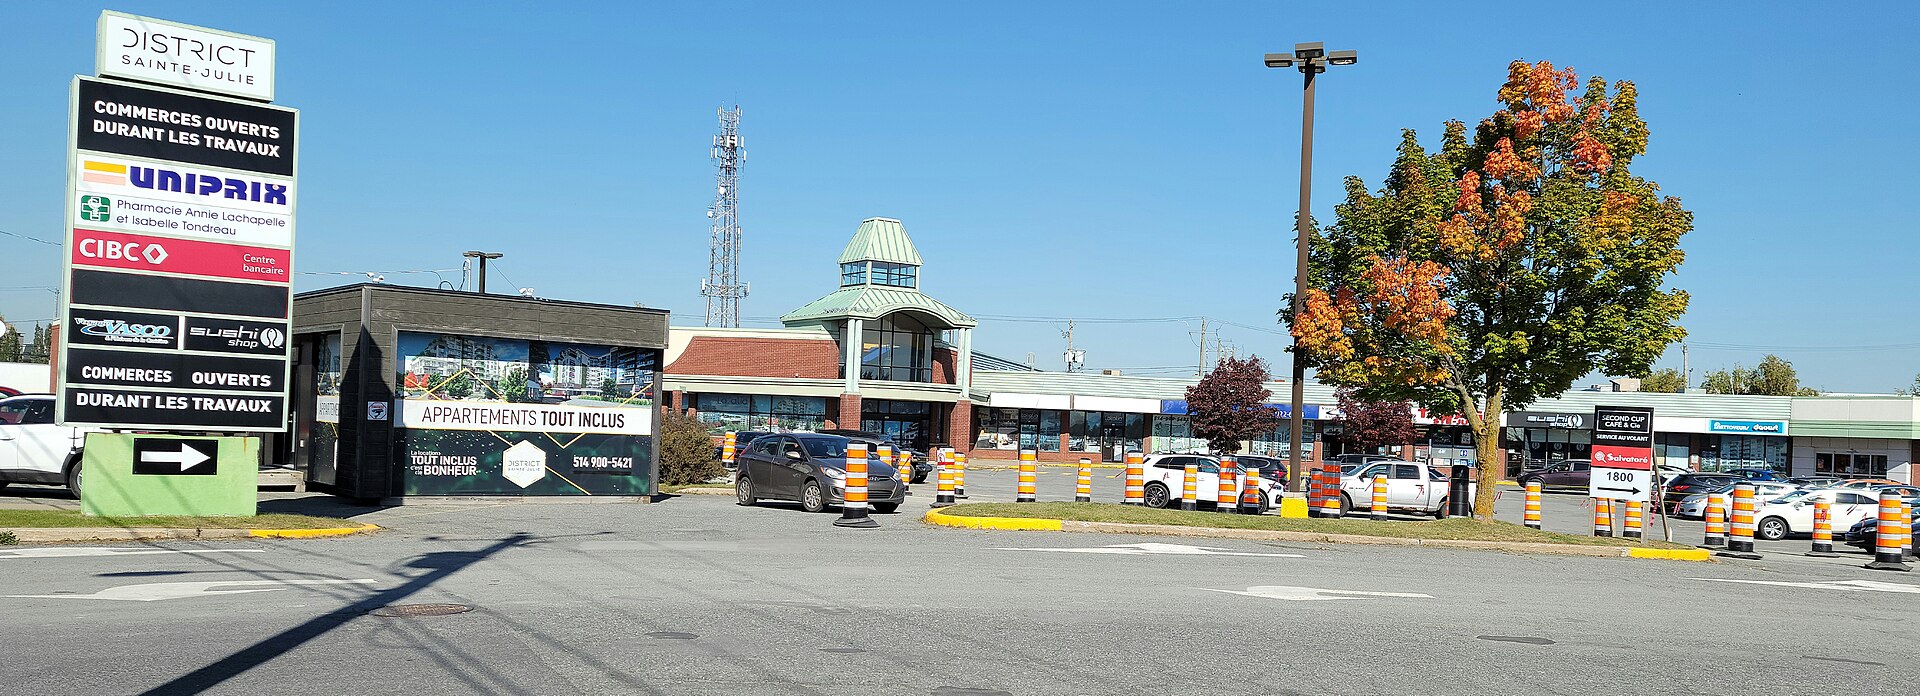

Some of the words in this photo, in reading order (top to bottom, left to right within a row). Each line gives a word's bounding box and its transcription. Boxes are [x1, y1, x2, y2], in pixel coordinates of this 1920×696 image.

[123, 28, 255, 67] DISTRICT
[94, 100, 201, 128] COMMERCES
[205, 117, 280, 139] OUVERTS
[93, 119, 165, 141] DURANT
[168, 129, 200, 146] LES
[204, 134, 280, 158] TRAVAUX
[130, 165, 287, 206] UNIPRIX
[117, 200, 182, 216] Pharmacie
[185, 207, 219, 220] Annie
[222, 209, 286, 228] Lachapelle
[116, 215, 129, 223] et
[132, 215, 179, 229] Isabelle
[182, 220, 237, 236] Tondreau
[79, 238, 140, 262] CIBC
[243, 253, 276, 265] Centre
[243, 263, 284, 275] bancaire
[103, 319, 170, 337] VASCO
[189, 325, 259, 339] sushi
[227, 338, 258, 349] shop
[82, 365, 172, 383] COMMERCES
[191, 371, 271, 387] OUVERTS
[76, 393, 151, 408] DURANT
[155, 394, 188, 410] LES
[191, 397, 272, 413] TRAVAUX
[421, 406, 537, 426] APPARTEMENTS
[540, 411, 575, 427] TOUT
[578, 412, 625, 428] INCLUS
[1527, 414, 1568, 422] sushi
[1601, 414, 1630, 422] SECOND
[410, 455, 439, 465] TOUT
[440, 455, 477, 466] INCLUS
[573, 456, 589, 468] 514
[590, 456, 632, 469] 900-5421
[1607, 452, 1648, 464] Salvatoré
[423, 465, 477, 476] BONHEUR
[1606, 471, 1634, 482] 1800
